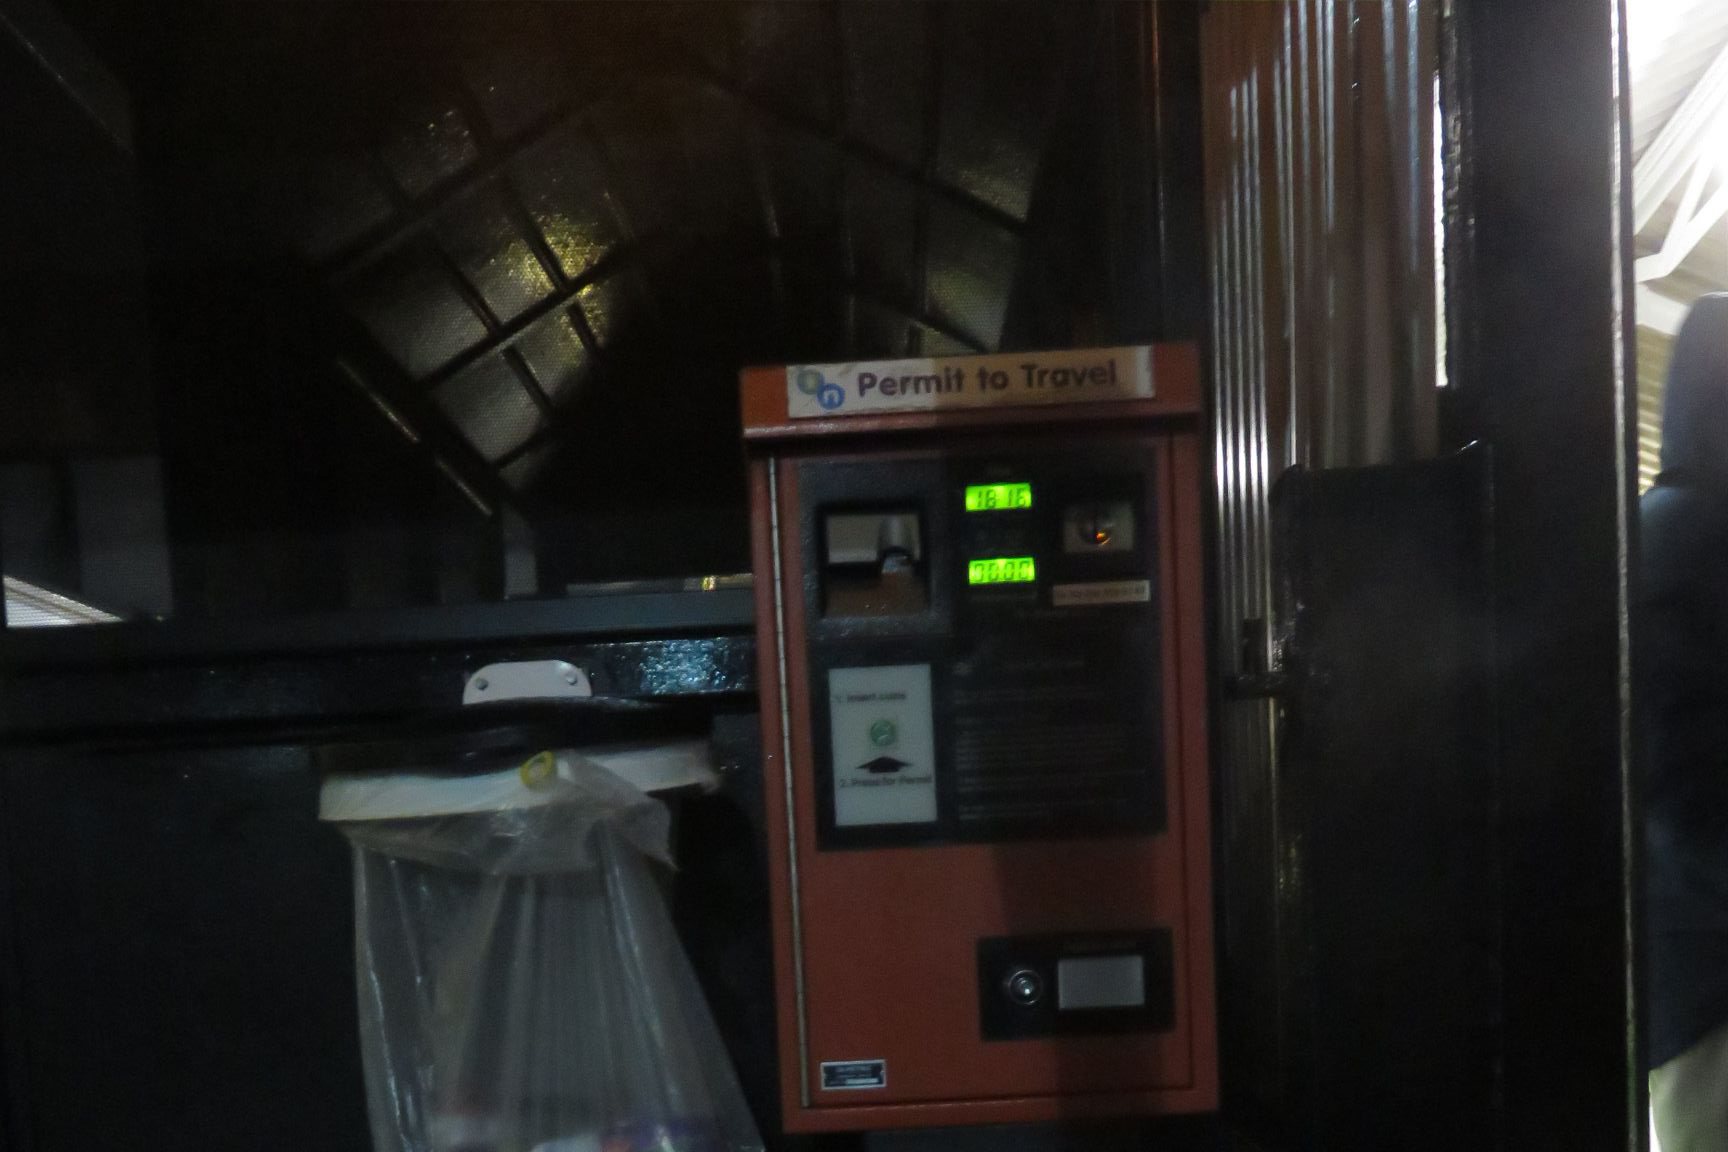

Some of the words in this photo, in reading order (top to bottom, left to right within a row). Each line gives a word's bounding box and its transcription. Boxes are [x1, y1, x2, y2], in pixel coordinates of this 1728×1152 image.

[857, 366, 964, 397] Permit
[977, 366, 1009, 393] to
[1020, 359, 1117, 389] Travel
